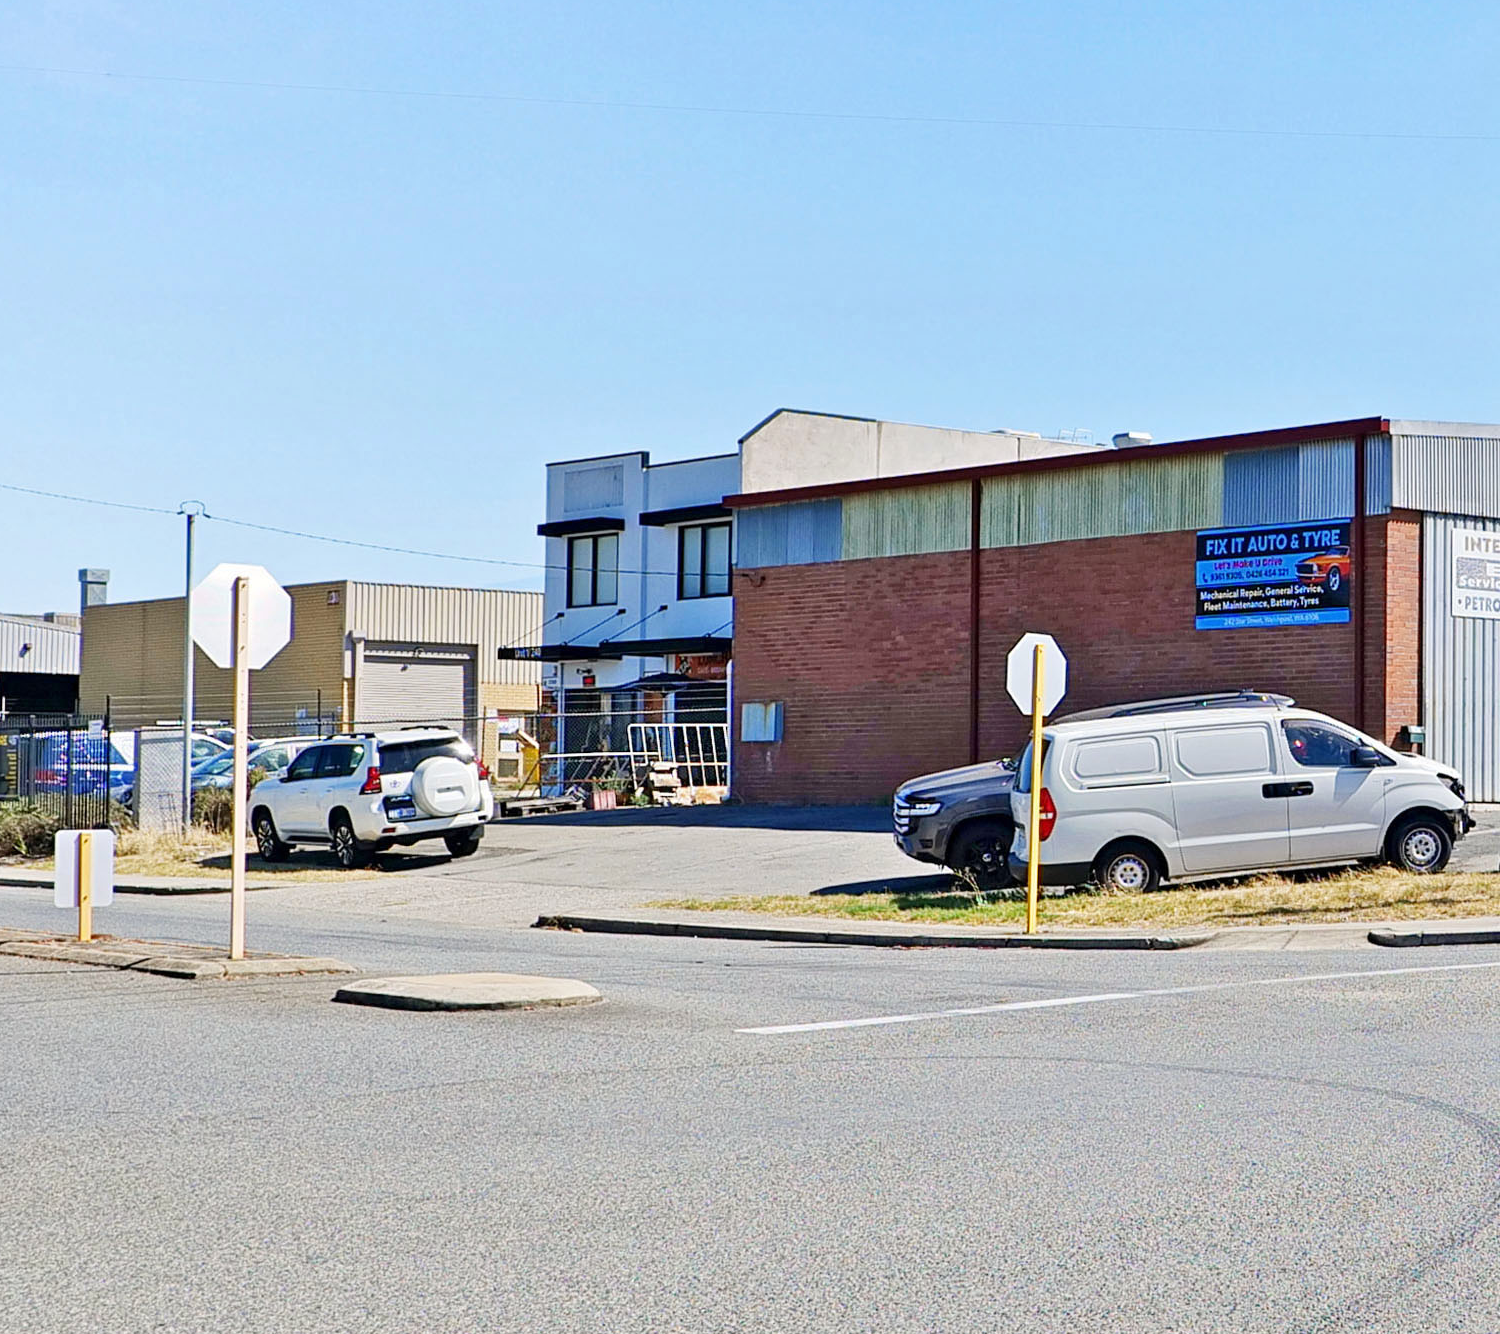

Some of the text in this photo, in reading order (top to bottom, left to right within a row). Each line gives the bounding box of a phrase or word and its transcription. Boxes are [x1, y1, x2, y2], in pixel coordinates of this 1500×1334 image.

[1206, 529, 1341, 555] FIX IT AUTO & TYRE
[1200, 583, 1324, 600] Mechanical Repair, General Service,
[1204, 596, 1319, 612] Fleet Maintenance, Battery, Tyres
